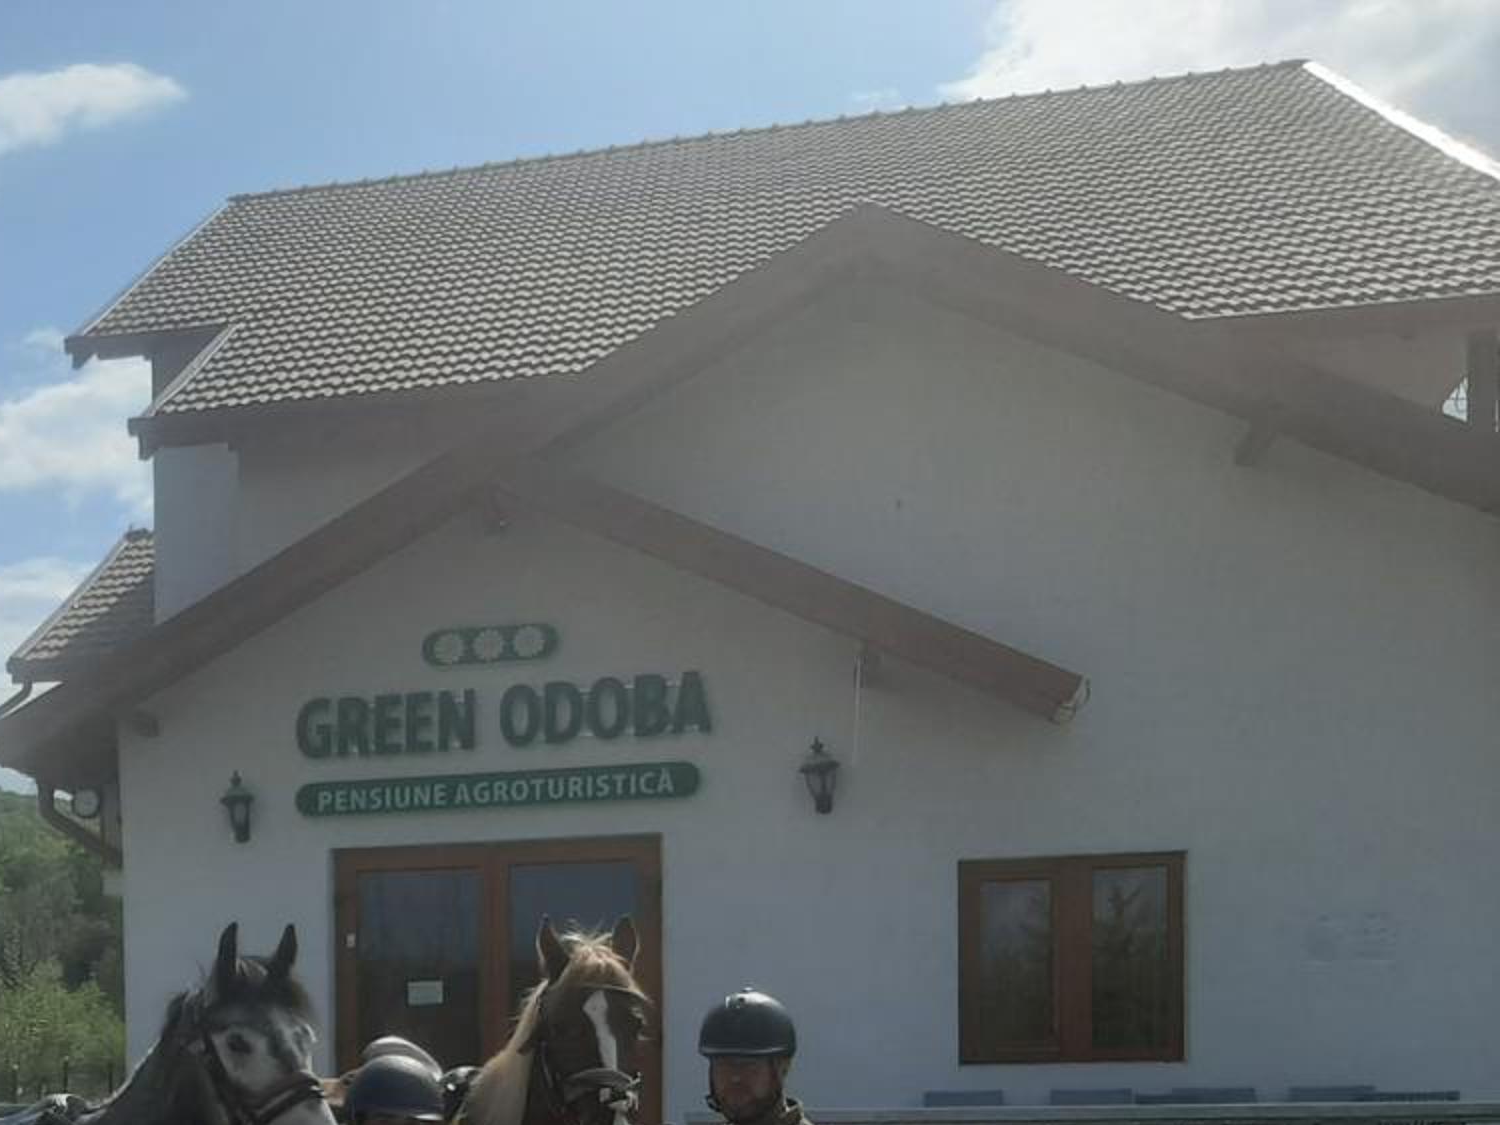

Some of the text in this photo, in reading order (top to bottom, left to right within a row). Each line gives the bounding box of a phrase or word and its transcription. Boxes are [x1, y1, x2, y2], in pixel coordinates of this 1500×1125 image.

[297, 671, 712, 759] GREEN ODOBA
[317, 784, 447, 812] PENSIUNE
